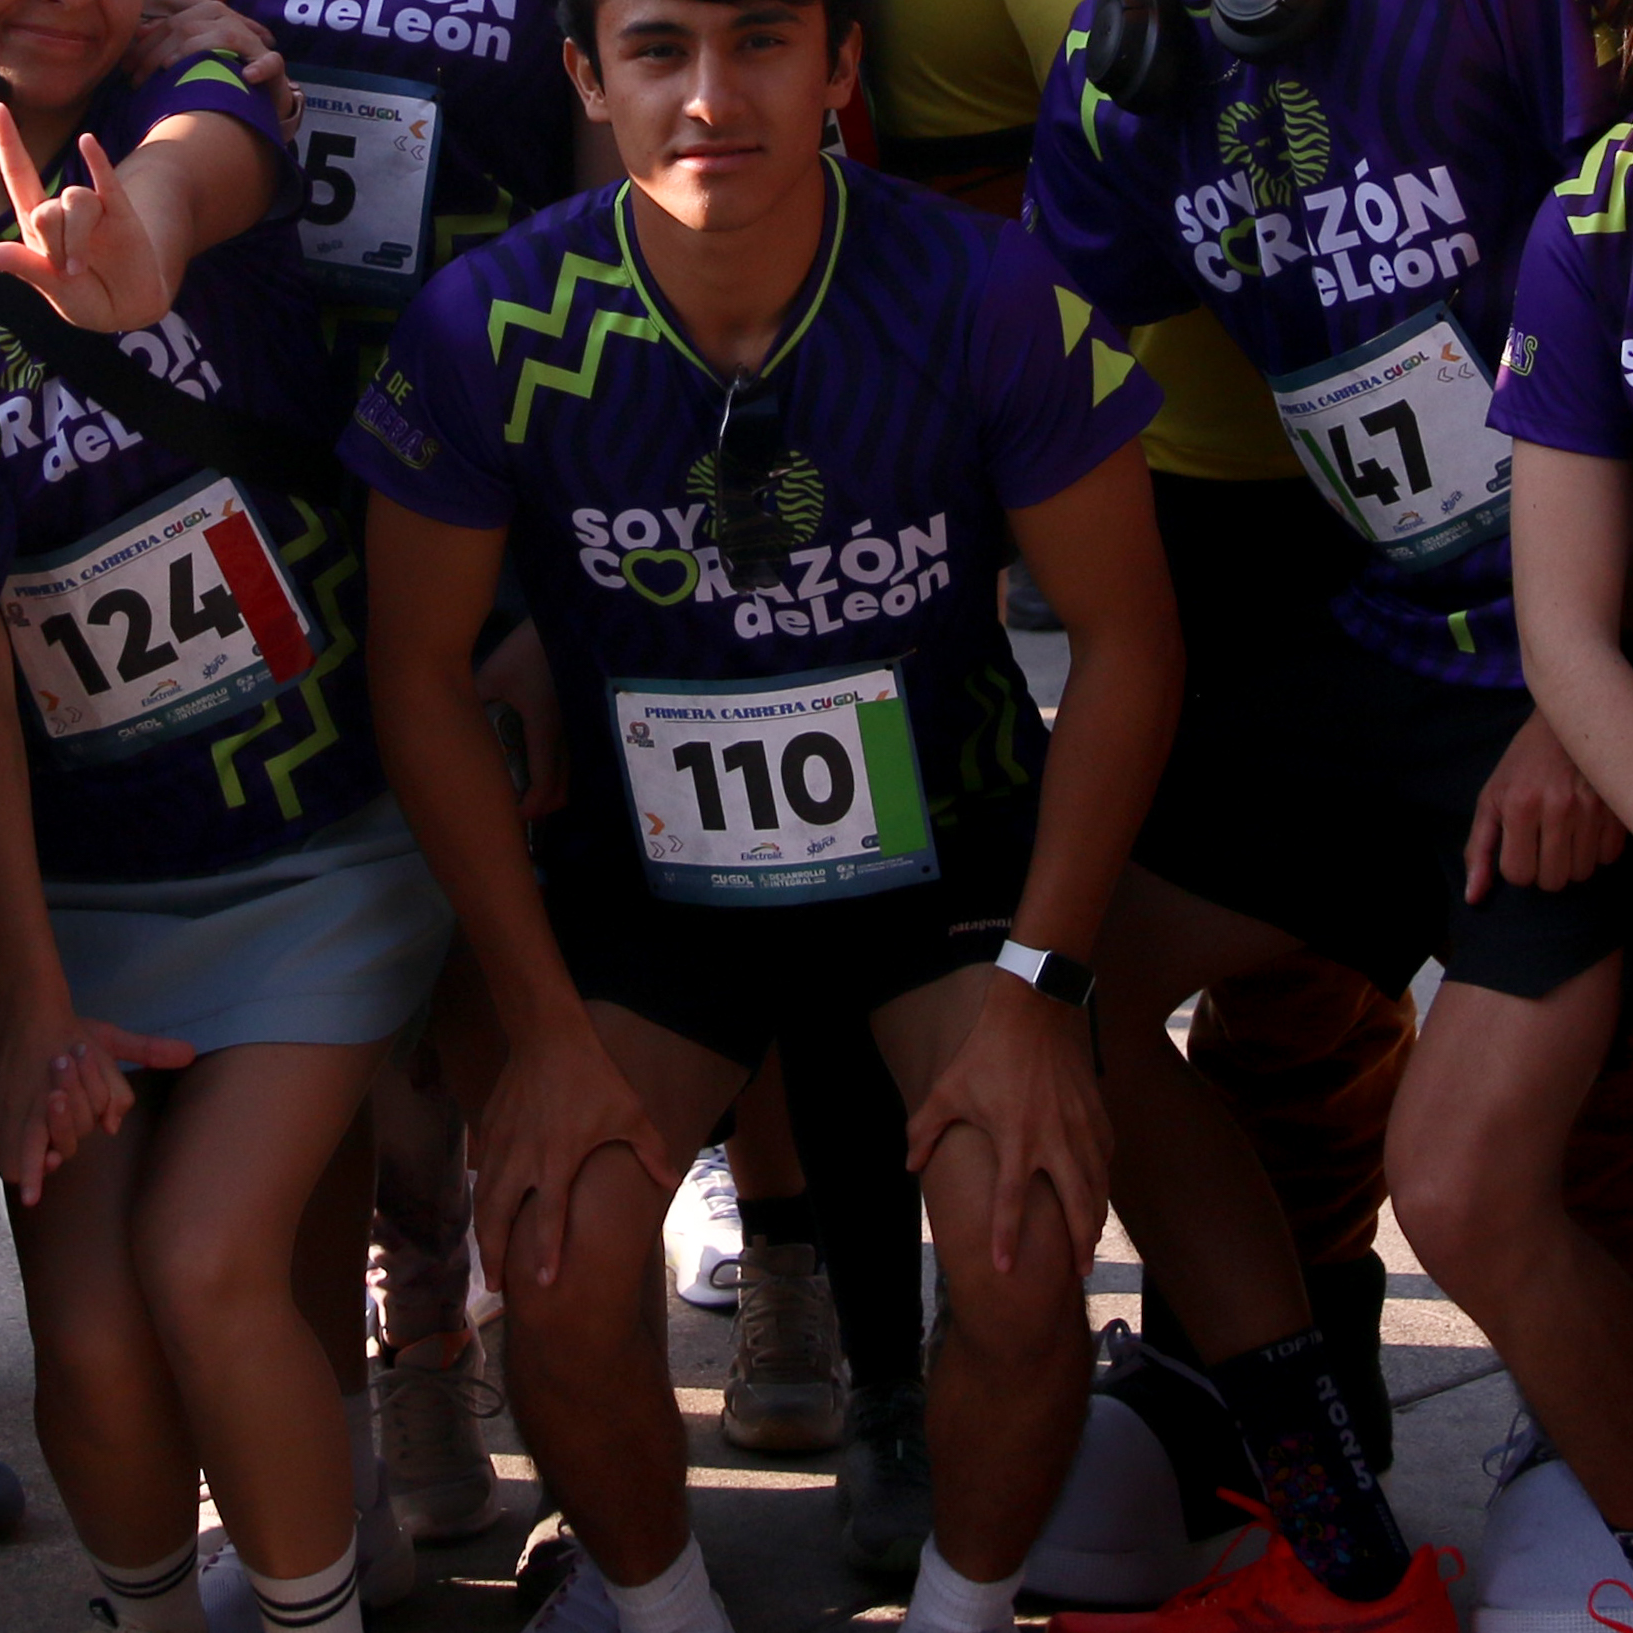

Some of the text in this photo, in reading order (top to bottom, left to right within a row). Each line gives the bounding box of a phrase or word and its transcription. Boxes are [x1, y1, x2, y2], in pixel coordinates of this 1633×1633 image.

[358, 104, 402, 122] CUGDL
[386, 370, 414, 406] DE
[1317, 375, 1383, 409] CARRERA
[1382, 350, 1430, 382] CUGDL
[1327, 398, 1433, 506] 47
[79, 534, 162, 582] CARRERA
[163, 507, 212, 538] CUGDL
[571, 503, 706, 551] SOY
[733, 559, 951, 640] deLeón
[40, 552, 245, 697] 124
[644, 690, 864, 721] PRIMERA CARRERA CUGDL
[672, 731, 855, 831] 110
[710, 872, 754, 889] CUGDL
[740, 850, 785, 863] Electrolit
[769, 868, 827, 881] DESARROLLO
[769, 876, 815, 889] INTEGRAL
[1315, 1374, 1375, 1491] 2025
